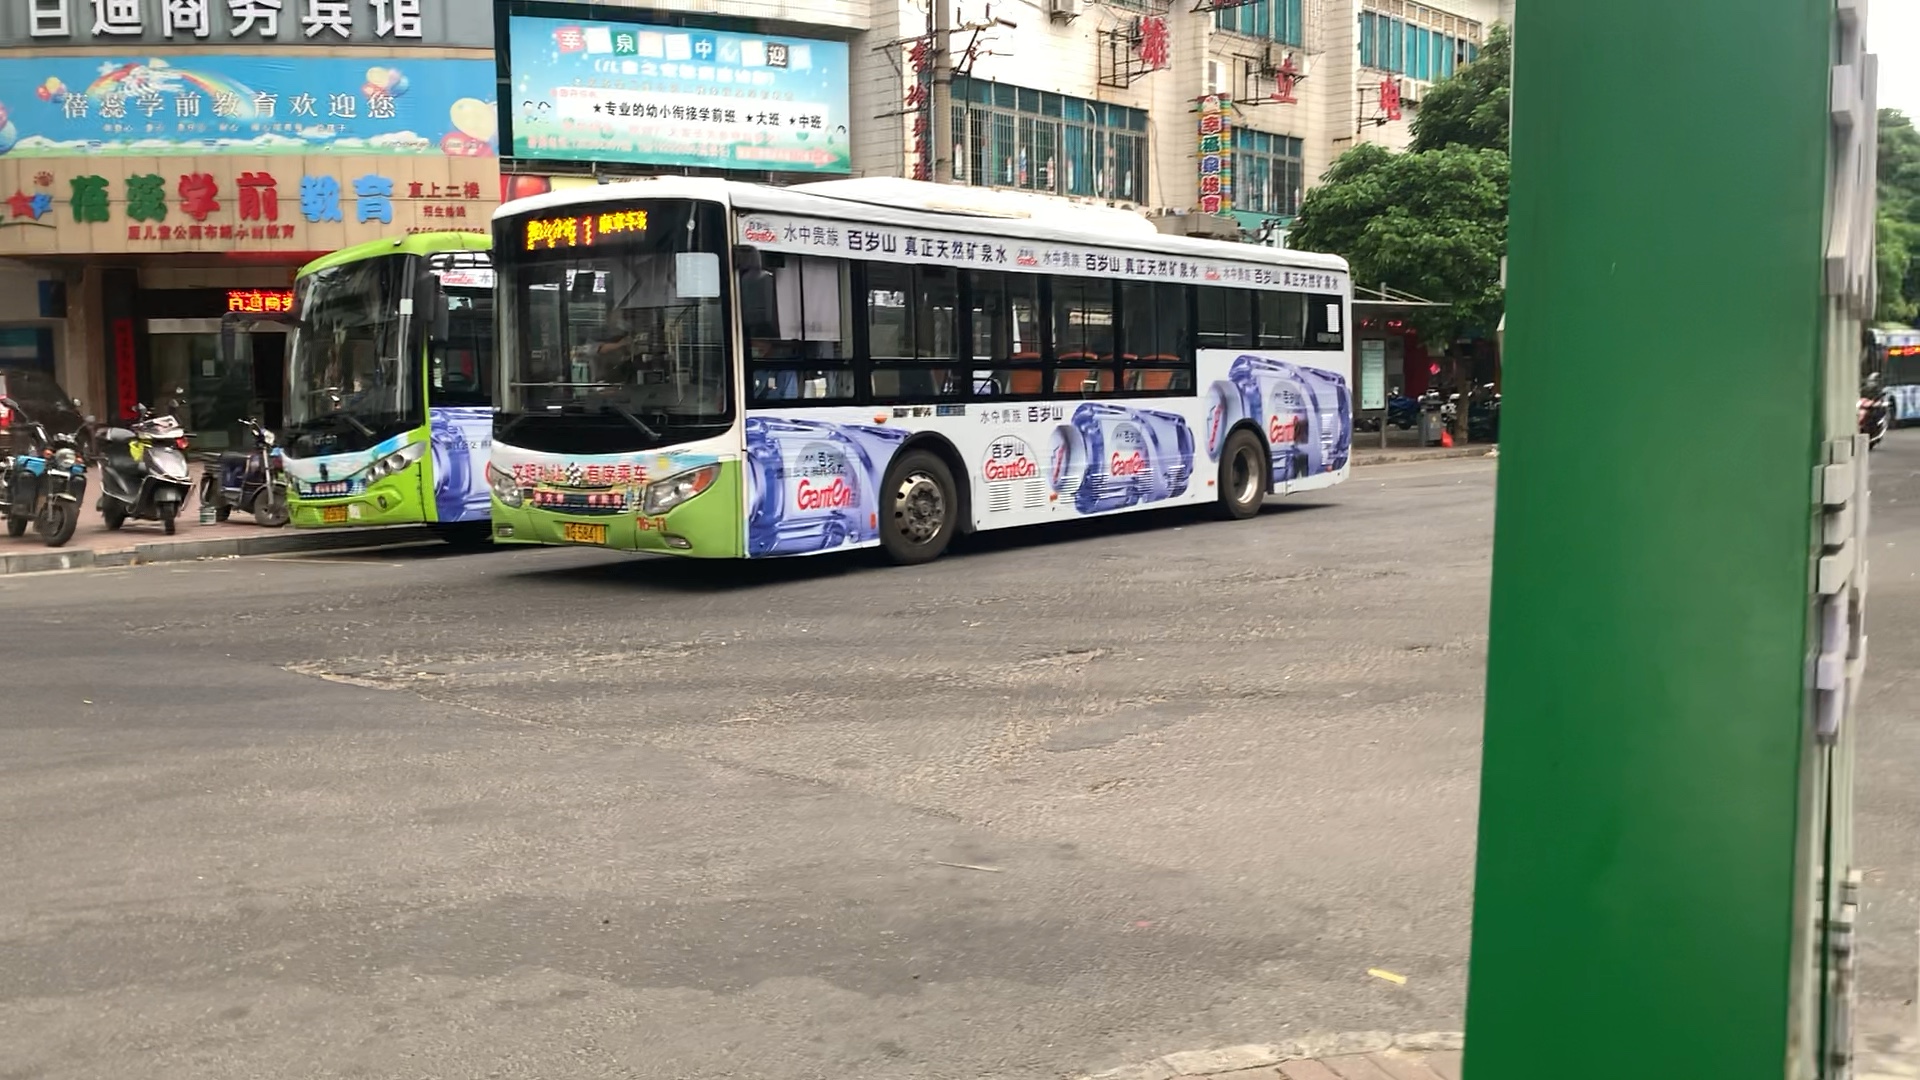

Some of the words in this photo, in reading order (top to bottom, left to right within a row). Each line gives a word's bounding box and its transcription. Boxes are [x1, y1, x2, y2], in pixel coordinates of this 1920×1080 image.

[63, 91, 396, 119] 蓓蕊学前教育欢迎您
[756, 110, 780, 126] 大班
[799, 114, 822, 129] 中班
[69, 171, 394, 225] 蓓蕊学前教育
[408, 181, 480, 199] 直上二楼
[784, 222, 839, 247] 水中贵族
[848, 229, 897, 252] 百岁山
[904, 235, 1007, 264] 真正天然矿泉水
[1085, 254, 1120, 272] 百岁山
[1125, 258, 1199, 279] 真正天然矿泉水
[1028, 406, 1063, 422] 百岁山
[992, 443, 1025, 458] 百岁山
[512, 463, 564, 482] 文明礼让
[586, 463, 648, 485] 有序乘车
[984, 457, 1037, 481] Ganten
[797, 478, 852, 511] Ganten
